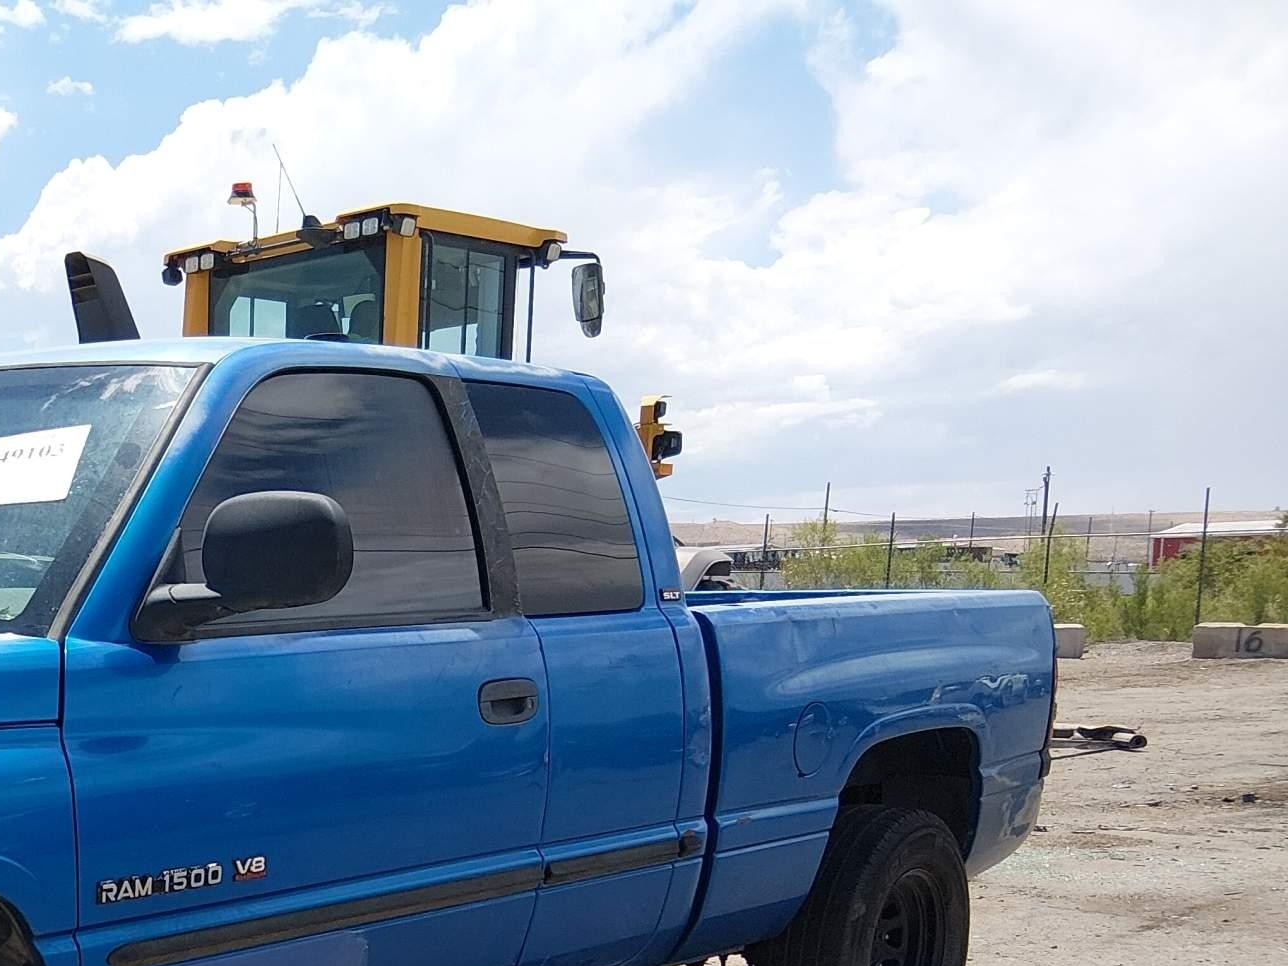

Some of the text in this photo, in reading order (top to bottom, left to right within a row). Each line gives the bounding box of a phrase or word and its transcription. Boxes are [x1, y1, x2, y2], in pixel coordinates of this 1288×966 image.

[663, 591, 680, 600] SLT
[1234, 627, 1263, 653] 16
[100, 856, 266, 904] RAM 1500 V8
